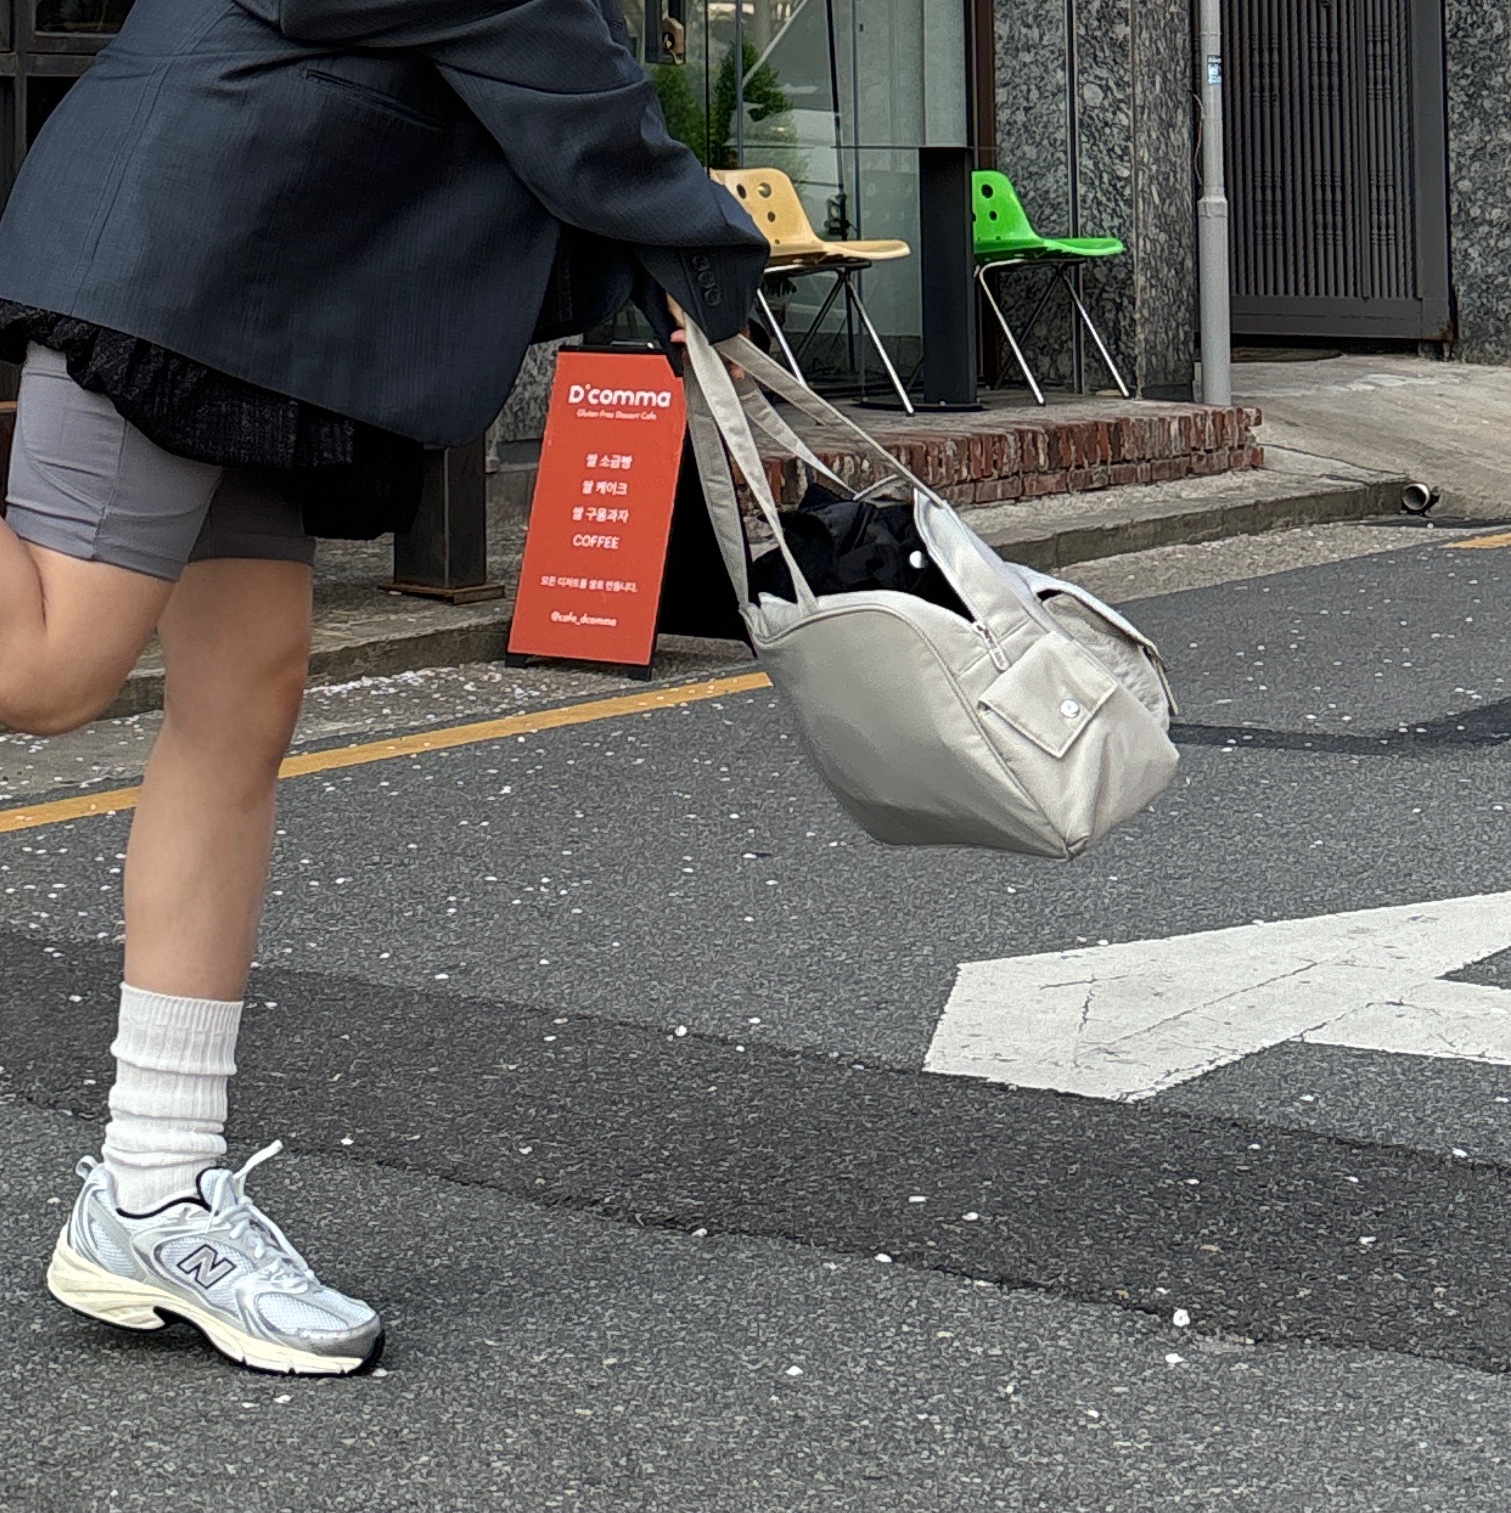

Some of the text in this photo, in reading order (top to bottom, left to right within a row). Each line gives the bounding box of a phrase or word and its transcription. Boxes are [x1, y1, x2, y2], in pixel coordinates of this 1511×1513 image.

[568, 384, 671, 407] D'comma
[586, 453, 632, 469] 쌀 소금빵
[582, 479, 627, 495] 쌀 케이크
[572, 506, 629, 523] 쌀 구움과자
[572, 534, 620, 549] COFFEE
[540, 575, 556, 587] 모든
[550, 610, 617, 627] @cafe_dcomma
[176, 1244, 237, 1290] N
